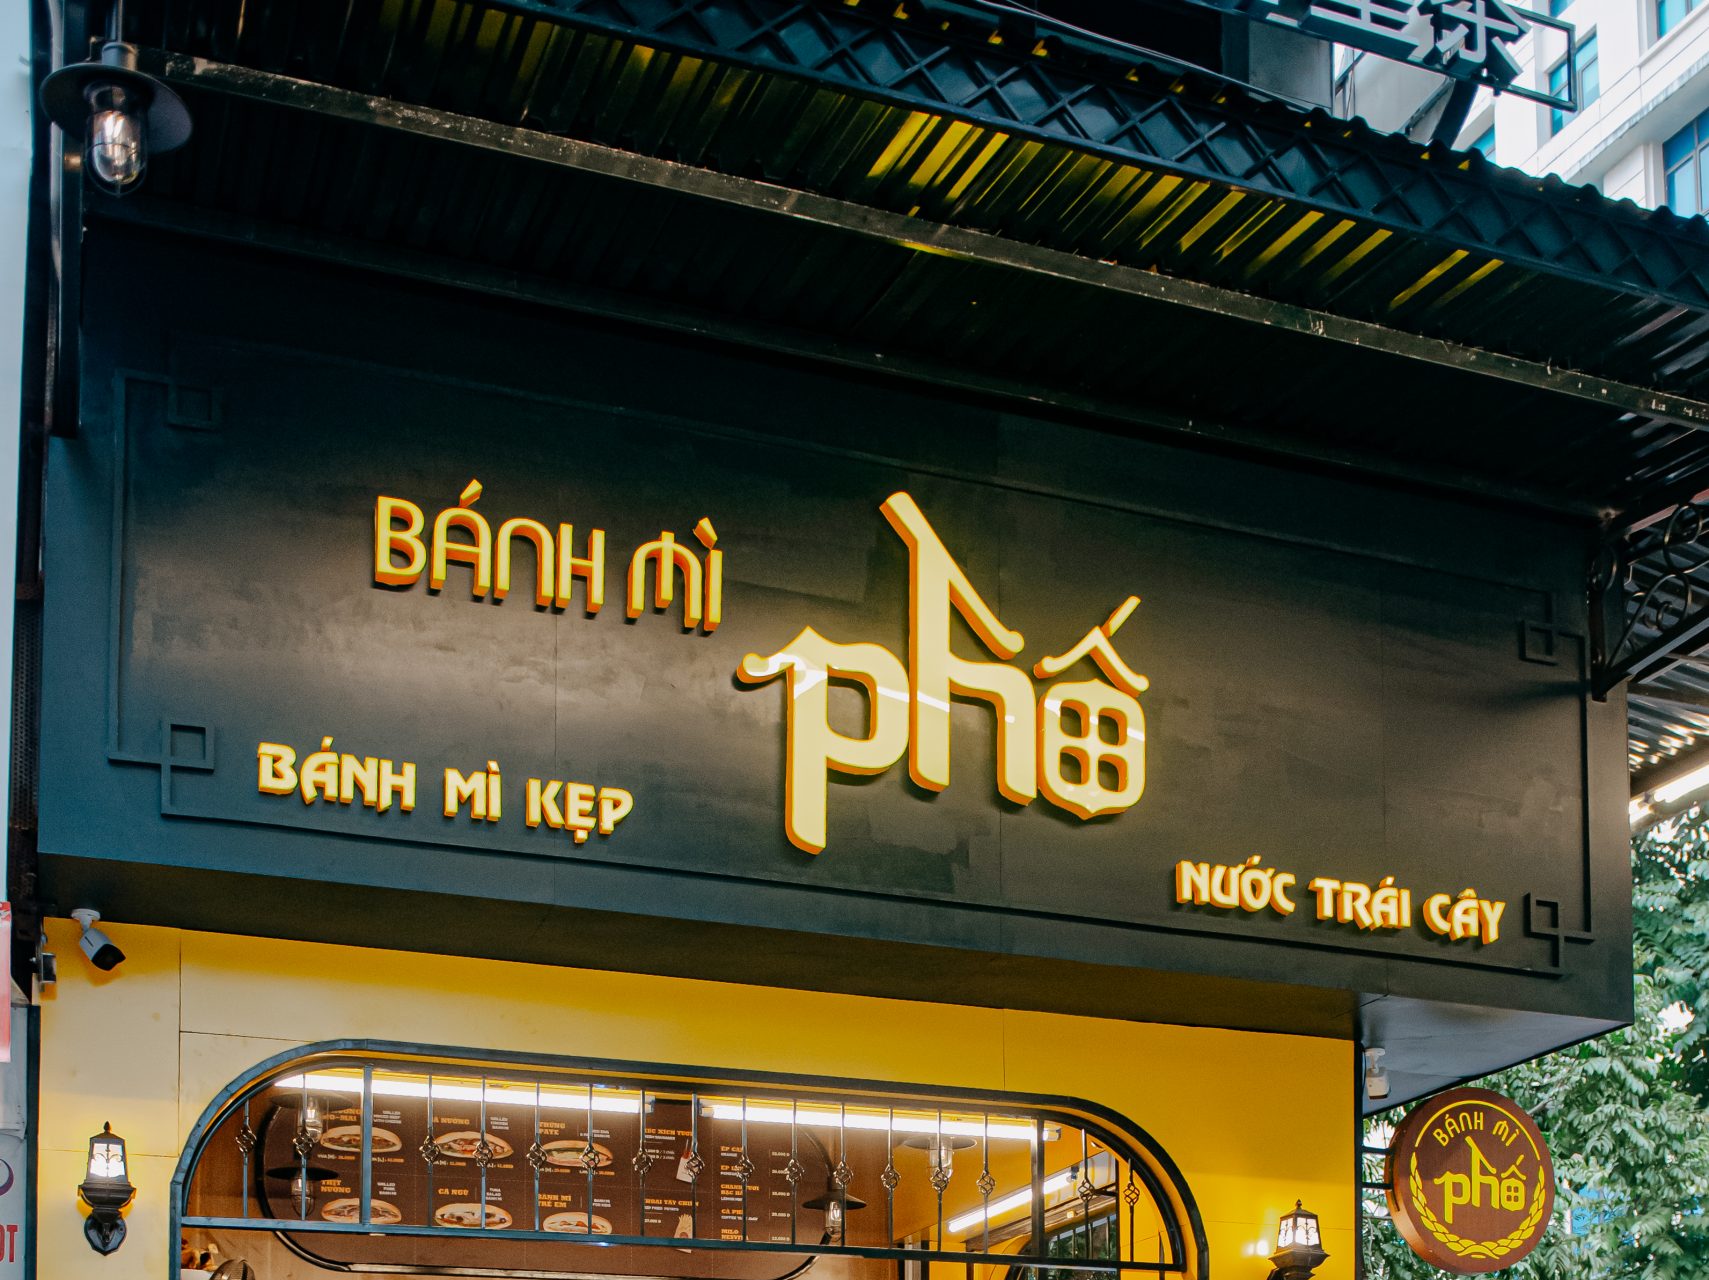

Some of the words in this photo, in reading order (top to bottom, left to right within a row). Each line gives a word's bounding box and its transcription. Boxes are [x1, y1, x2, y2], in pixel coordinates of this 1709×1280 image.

[374, 479, 605, 614] BÁNH
[627, 516, 723, 632] MÌ
[737, 490, 1150, 855] phố
[256, 736, 417, 813] BÁNH
[442, 760, 502, 823] MÌ
[525, 777, 634, 844] KẸP
[1175, 854, 1296, 917] NƯỚC
[1307, 876, 1412, 932] TRÁI
[1422, 887, 1507, 945] CÂY
[1432, 1111, 1485, 1147] BÁNH
[1492, 1120, 1520, 1147] MÌ
[1433, 1135, 1528, 1225] phố
